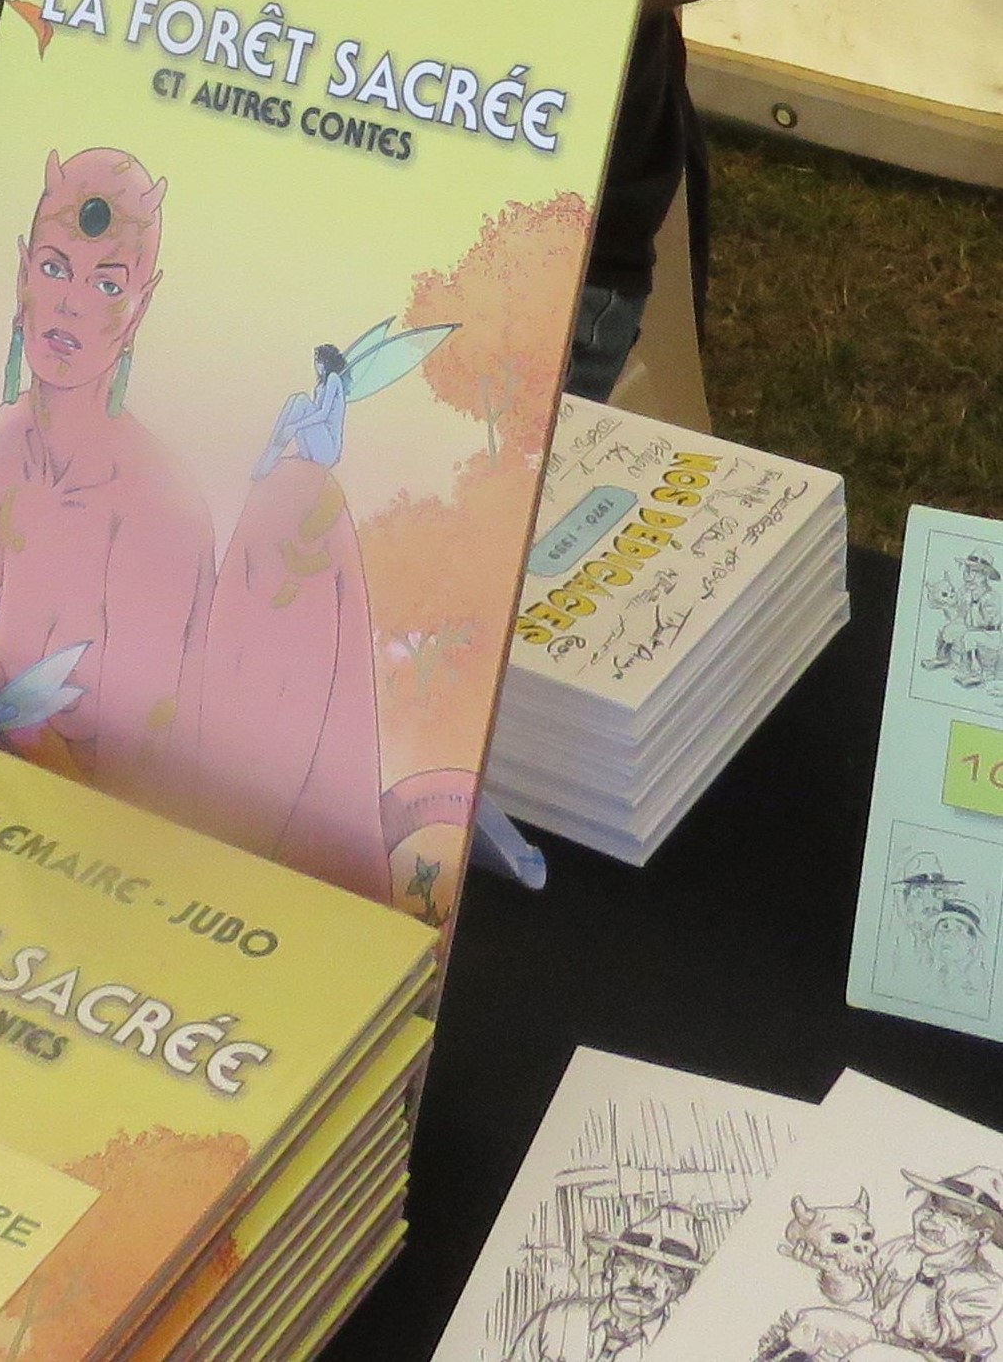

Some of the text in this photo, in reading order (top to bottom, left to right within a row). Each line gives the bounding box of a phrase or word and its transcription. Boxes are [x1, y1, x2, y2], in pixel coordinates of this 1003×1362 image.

[152, 69, 412, 161] ET AUTRES CONTES
[327, 41, 568, 153] SACRÉE
[651, 452, 723, 507] NOS
[168, 900, 280, 960] JUBO
